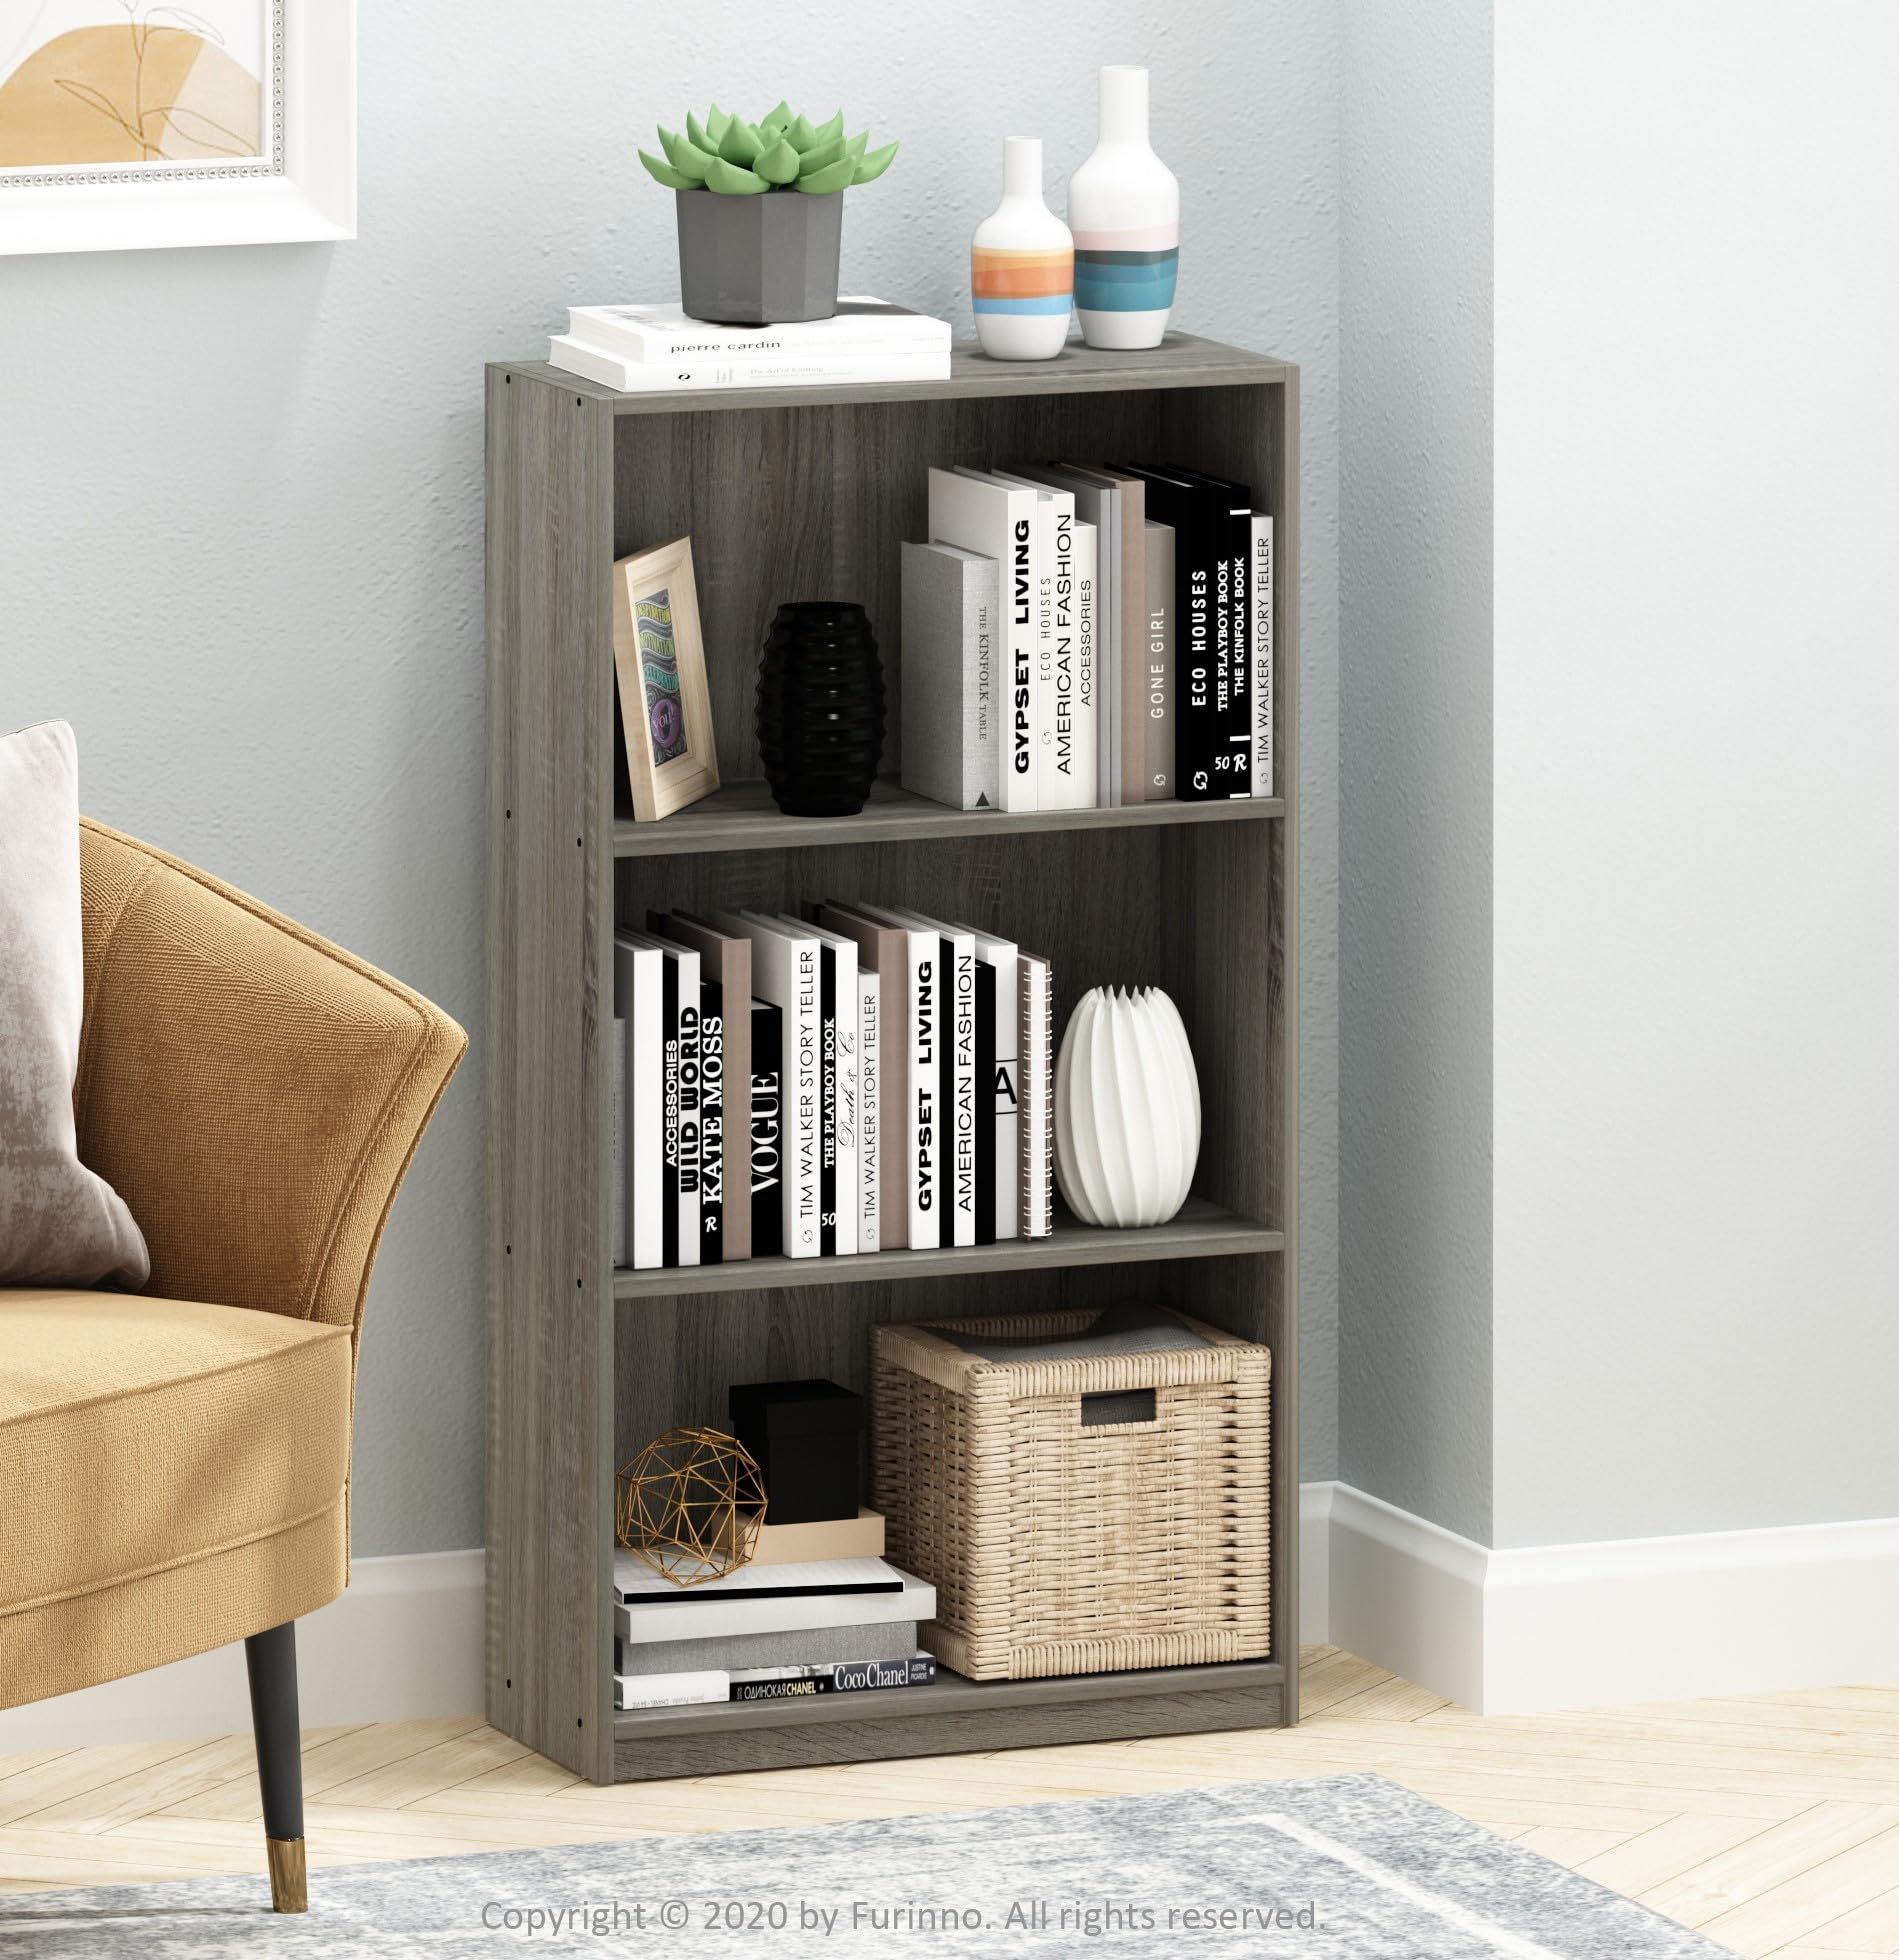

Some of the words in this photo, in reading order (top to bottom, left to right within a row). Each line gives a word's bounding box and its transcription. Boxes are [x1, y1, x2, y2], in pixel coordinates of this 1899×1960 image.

[670, 343, 721, 354] pierre
[727, 340, 781, 351] cardin
[1014, 519, 1030, 625] LIVING
[1057, 513, 1071, 628] FASHION
[1217, 560, 1228, 604] BOOK
[1234, 557, 1245, 598] BOOK
[1257, 537, 1269, 593] TELLER
[979, 606, 988, 630] THE
[1040, 577, 1051, 640] HOUSES
[1151, 608, 1165, 653] GIRL
[1191, 570, 1207, 652] HOUSES
[1234, 602, 1245, 663] KINFOLK
[1257, 598, 1269, 653] STORY
[979, 633, 990, 701] KINFOLK
[1040, 651, 1051, 681] ECO
[1080, 579, 1092, 707] ACCESSORIES
[1217, 607, 1228, 677] PLAYBOY
[1014, 648, 1030, 775] GYPSET
[1057, 637, 1071, 776] AMERICAN
[1151, 663, 1165, 719] GONE
[1191, 667, 1207, 706] ECO
[1217, 680, 1228, 712] THE
[1234, 667, 1245, 696] THE
[1257, 659, 1269, 729] WALKER
[979, 704, 988, 740] TABLE
[1257, 734, 1269, 764] TIM
[1215, 756, 1230, 770] 50
[800, 951, 814, 1017] TELLER
[918, 961, 932, 1065] LIVING
[958, 955, 972, 1067] FASHION
[824, 1017, 835, 1061] BOOK
[837, 1031, 855, 1058] Co
[864, 995, 876, 1051] TELLER
[680, 1006, 699, 1112] WORLD
[702, 1015, 723, 1109] MOSS
[800, 1023, 814, 1088] STORY
[864, 1056, 876, 1110] STORY
[666, 1040, 678, 1168] ACCESSORIES
[824, 1064, 835, 1134] PLAYBOY
[838, 1082, 856, 1148] Death
[680, 1120, 699, 1194] WILD
[702, 1116, 723, 1205] KATE
[750, 1072, 780, 1196] VOGUE
[800, 1094, 814, 1178] WALKER
[824, 1137, 835, 1169] THE
[864, 1115, 876, 1185] WALKER
[918, 1087, 932, 1212] GYPSET
[958, 1077, 972, 1213] AMERICAN
[800, 1184, 814, 1219] TIM
[821, 1212, 836, 1226] 50
[864, 1190, 876, 1220] TIM
[786, 1681, 816, 1696] CHANEL
[834, 1665, 866, 1690] Coco
[866, 1660, 909, 1688] Chanel
